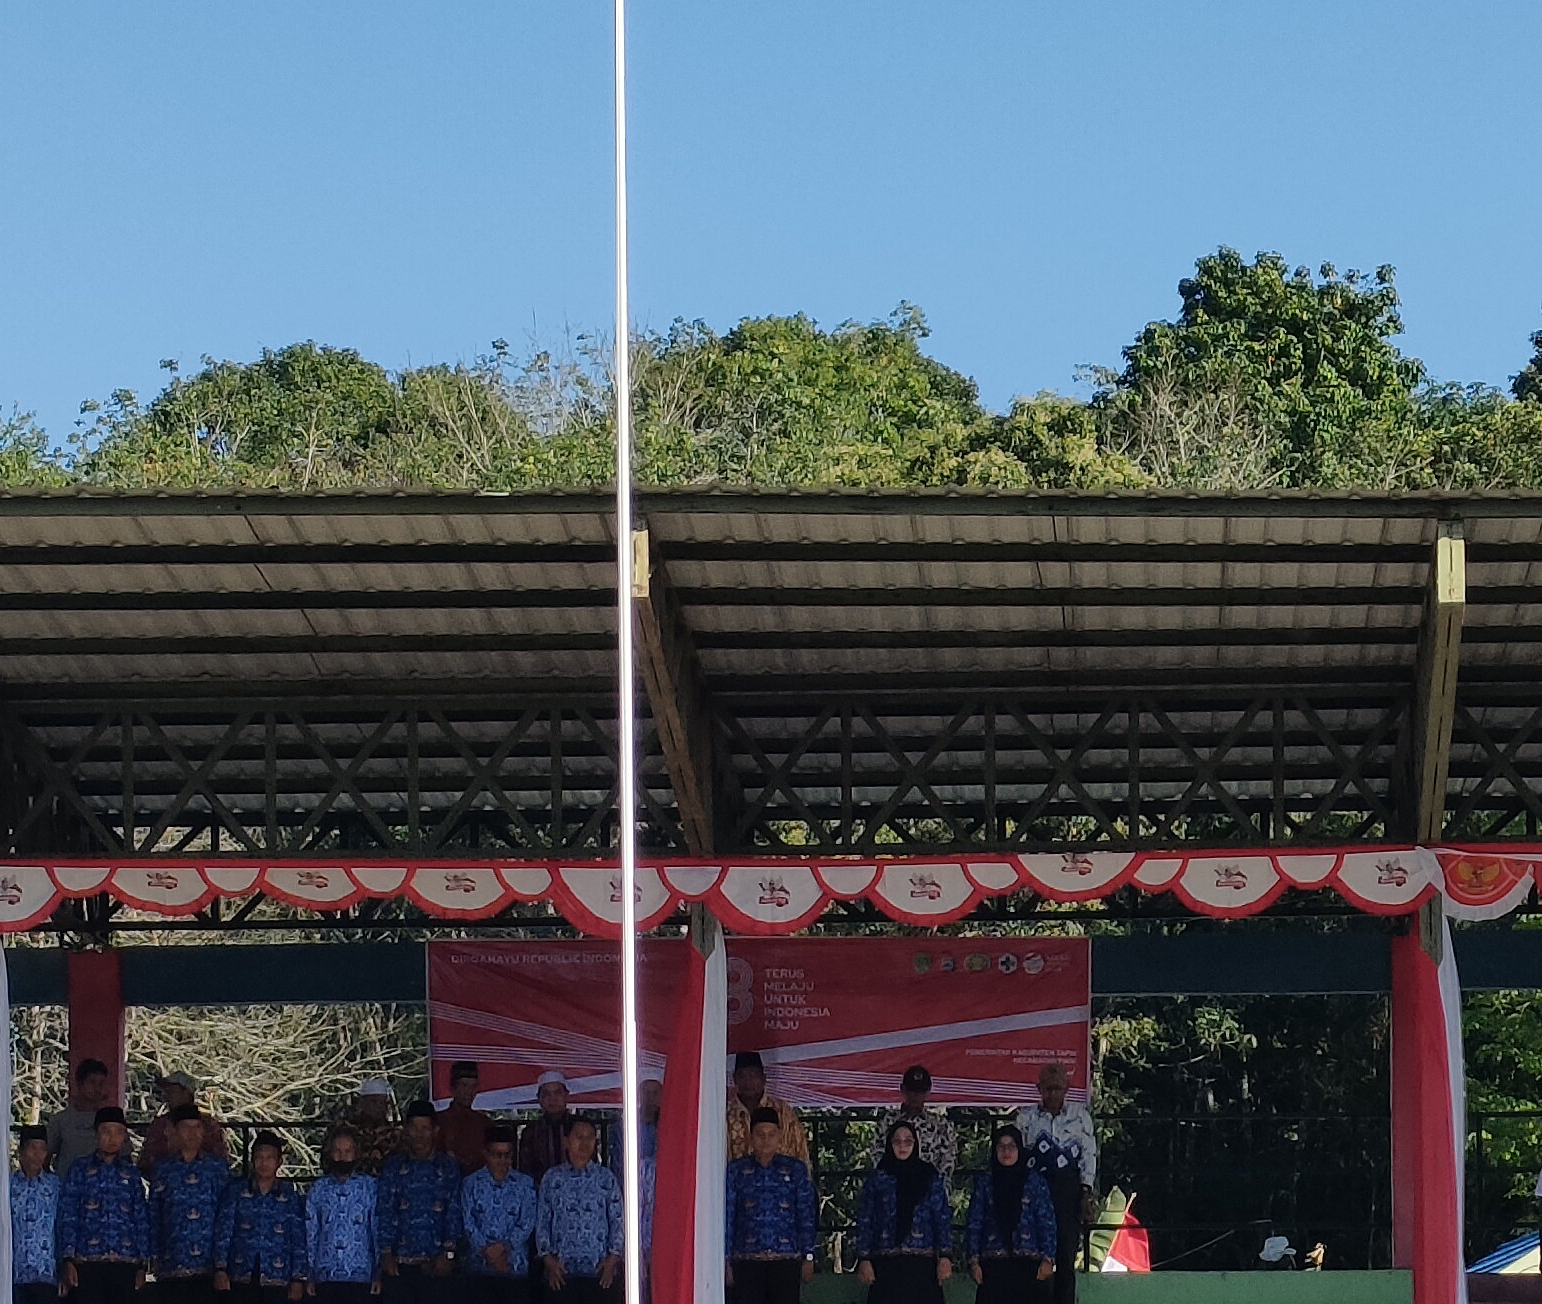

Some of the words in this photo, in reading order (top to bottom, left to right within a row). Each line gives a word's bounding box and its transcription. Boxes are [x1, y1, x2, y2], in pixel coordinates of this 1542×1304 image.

[522, 953, 580, 963] REPUBLIK
[763, 968, 805, 979] TERUS
[763, 981, 815, 992] MELAJU
[763, 993, 806, 1005] UNTUK
[763, 1006, 831, 1017] INDONESIA
[763, 1019, 800, 1030] MAJU
